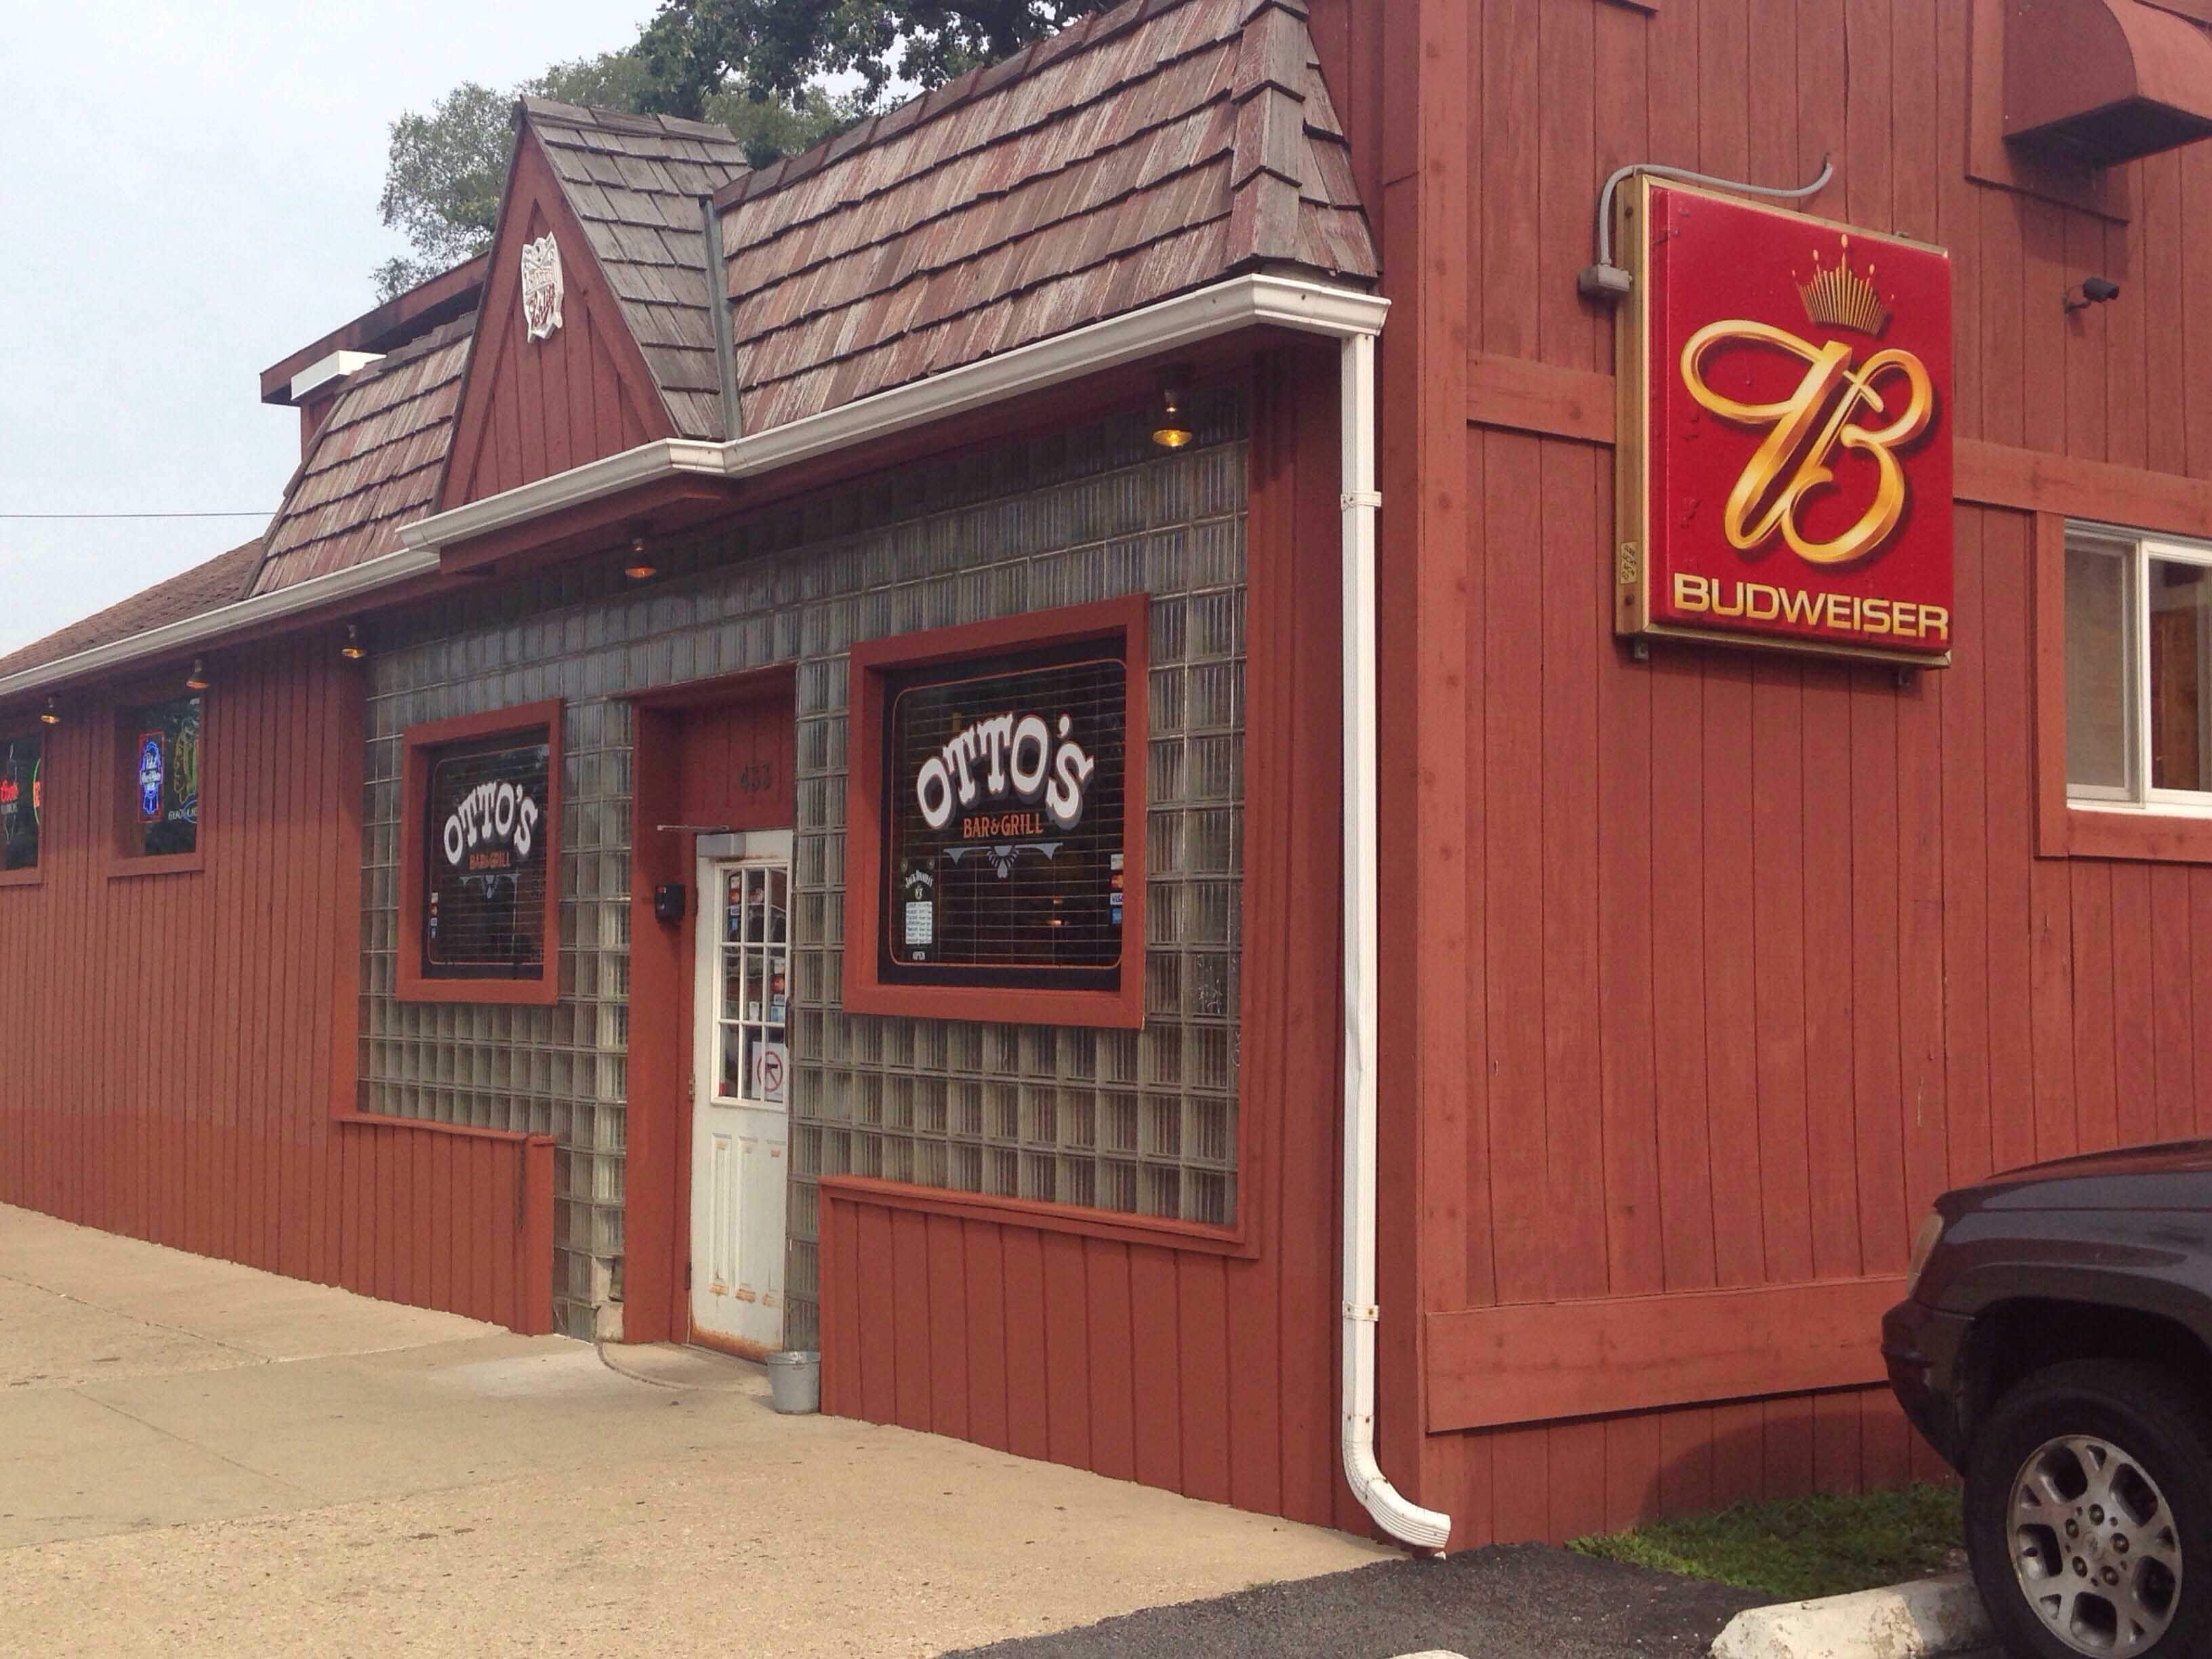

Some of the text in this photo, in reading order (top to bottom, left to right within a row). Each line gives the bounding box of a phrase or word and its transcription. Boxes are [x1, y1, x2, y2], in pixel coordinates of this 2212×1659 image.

[1673, 573, 1949, 640] BUDWEISER
[916, 712, 1094, 830] OTTO'S
[443, 781, 539, 865] OTTO'S
